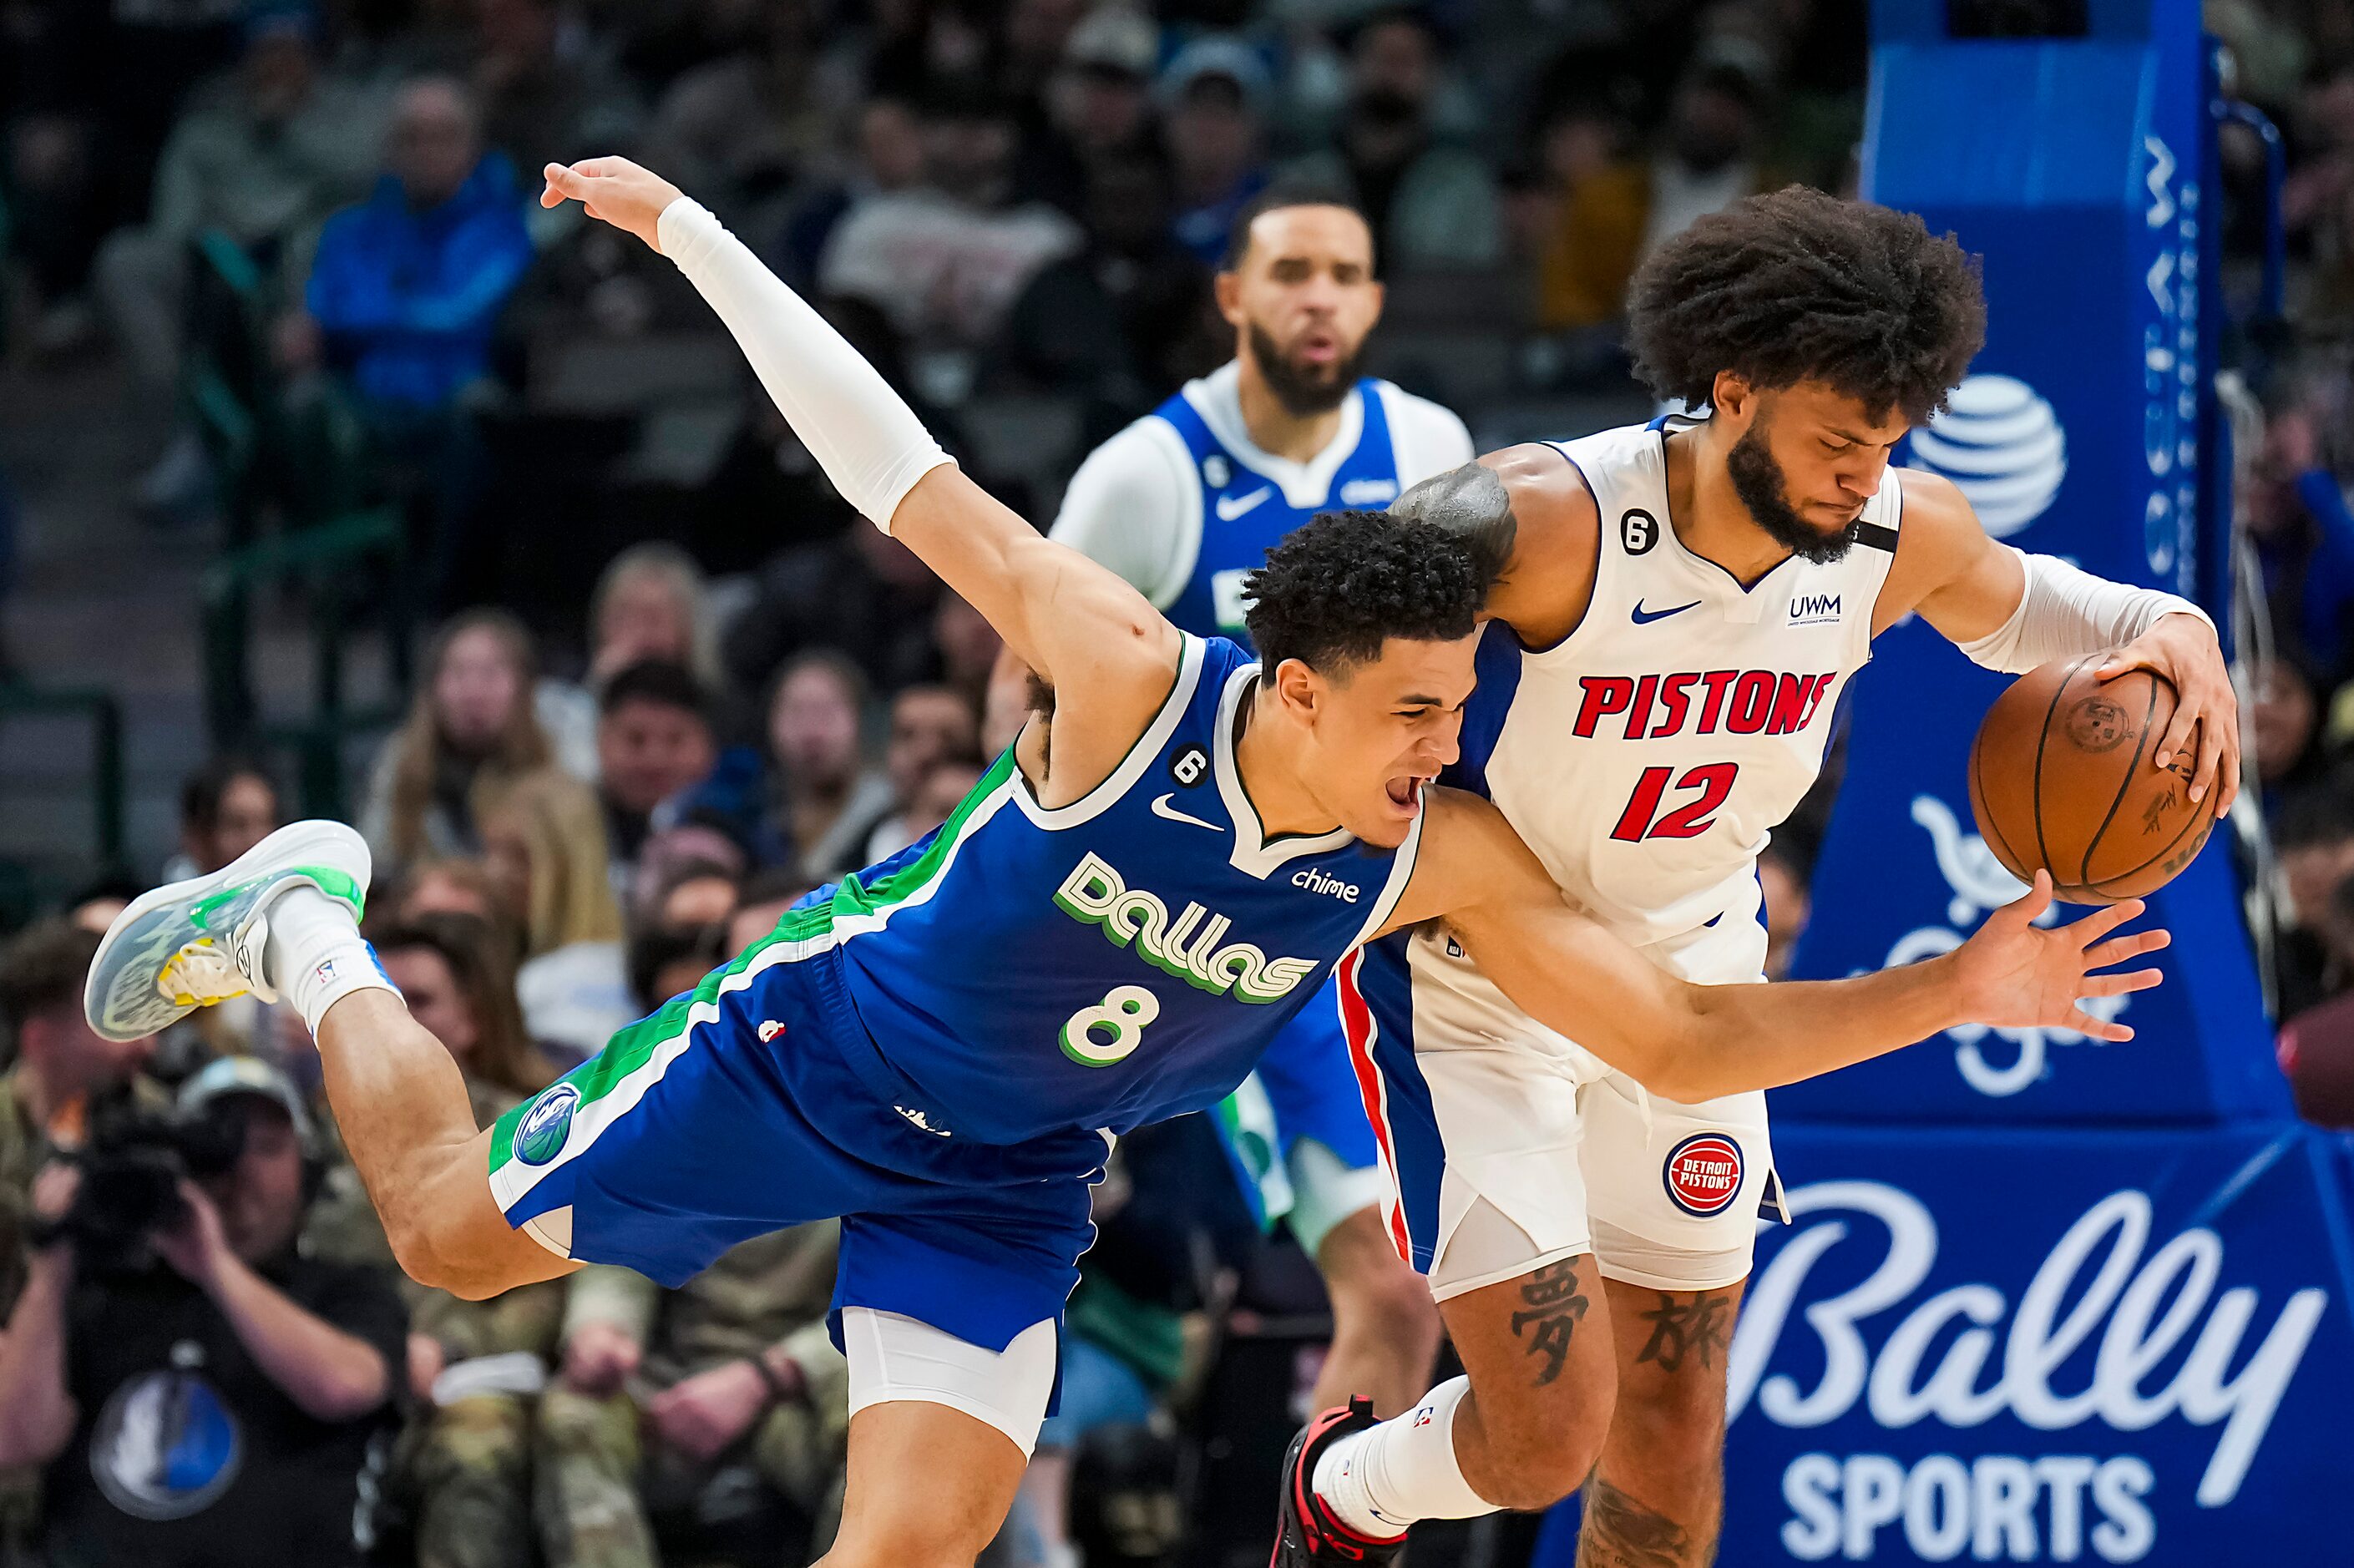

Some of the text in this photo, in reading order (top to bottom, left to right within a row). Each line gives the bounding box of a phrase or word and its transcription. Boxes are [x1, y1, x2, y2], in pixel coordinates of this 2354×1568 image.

[1624, 514, 1650, 551] 6
[1790, 594, 1841, 619] UWM
[1572, 669, 1837, 741] PISTONS
[1174, 749, 1207, 784] 6
[1609, 761, 1739, 843] 12
[1290, 867, 1360, 903] chime
[1058, 985, 1160, 1069] 8
[1679, 1171, 1732, 1190] PISTONS
[1683, 1158, 1734, 1176] DETROIT
[1725, 1180, 2328, 1508] Bally
[1780, 1452, 2157, 1562] SPORTS
